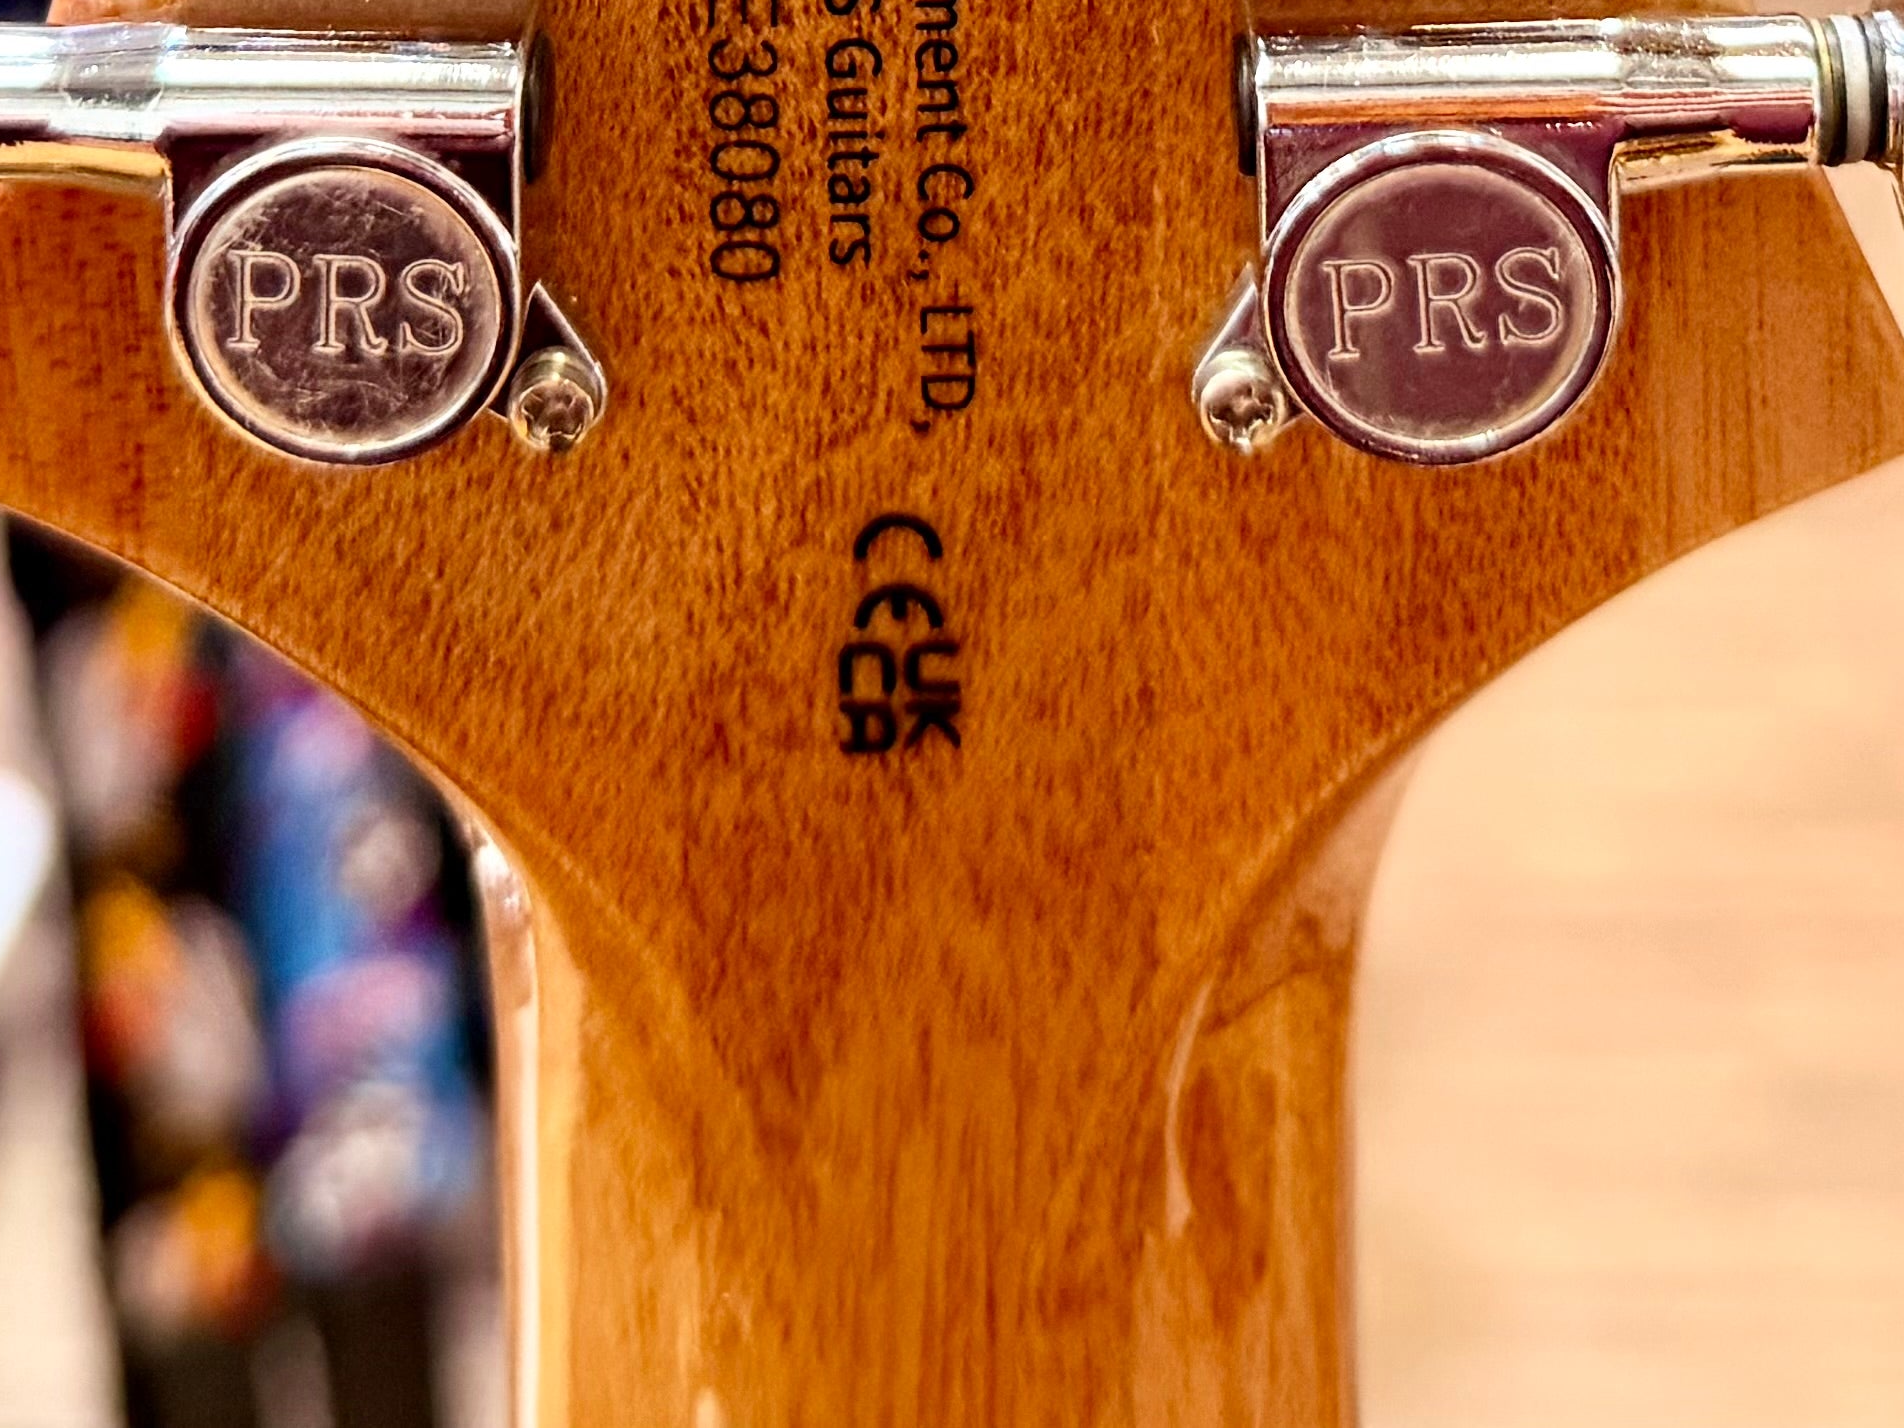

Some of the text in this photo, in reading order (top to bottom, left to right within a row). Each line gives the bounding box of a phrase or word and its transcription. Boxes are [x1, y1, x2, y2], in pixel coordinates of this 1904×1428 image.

[824, 37, 885, 266] Guitars
[907, 163, 975, 281] Co.,
[226, 249, 465, 356] PRS
[1322, 246, 1564, 360] PRS
[852, 513, 943, 630] CE
